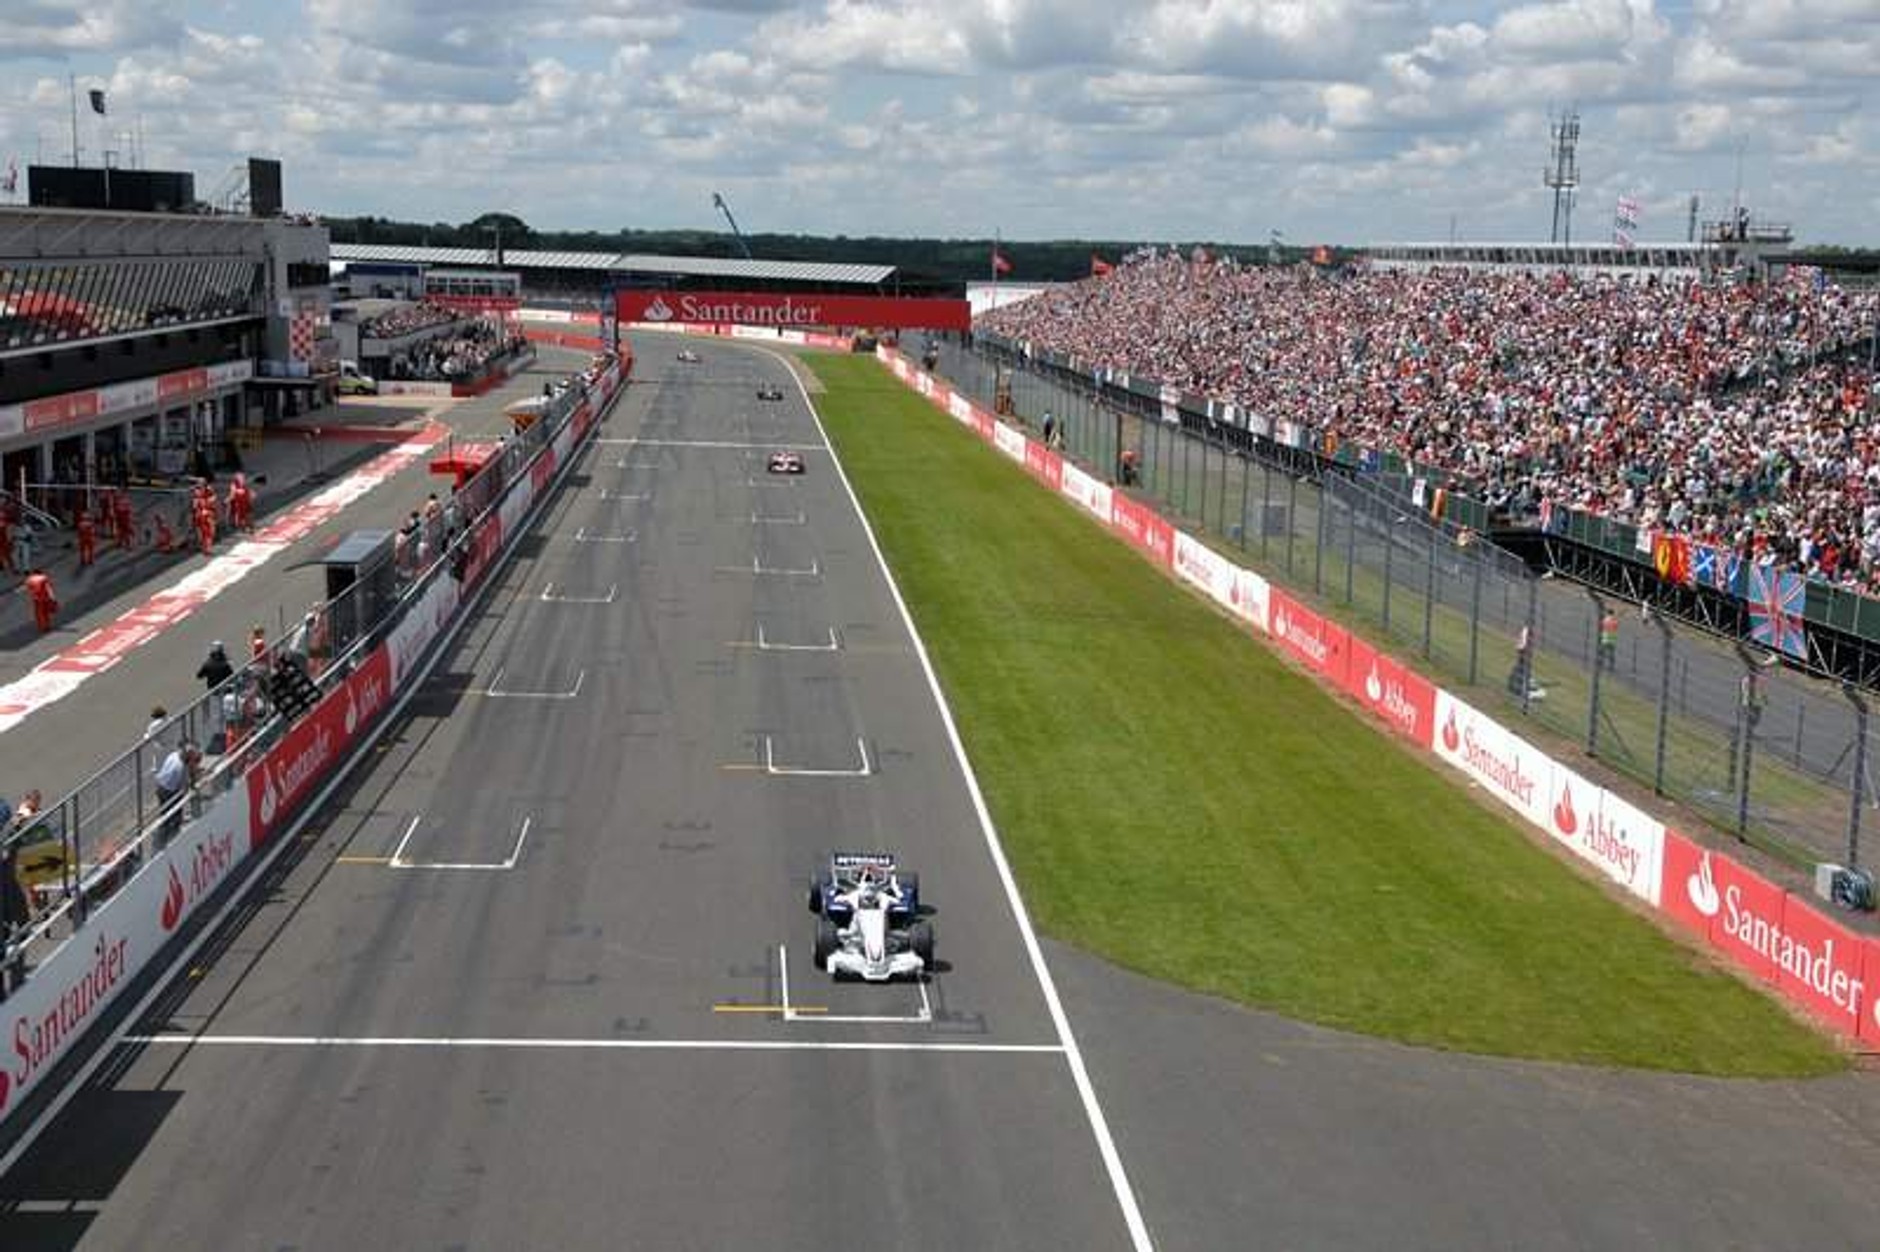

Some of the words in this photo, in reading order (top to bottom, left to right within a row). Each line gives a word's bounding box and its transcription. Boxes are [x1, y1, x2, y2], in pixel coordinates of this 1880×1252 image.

[679, 295, 821, 324] Santander
[1464, 726, 1534, 807] Santander
[1583, 812, 1640, 884] Abbey
[14, 934, 128, 1086] Santander
[189, 831, 233, 896] Abbey
[1724, 884, 1864, 1015] Santander
